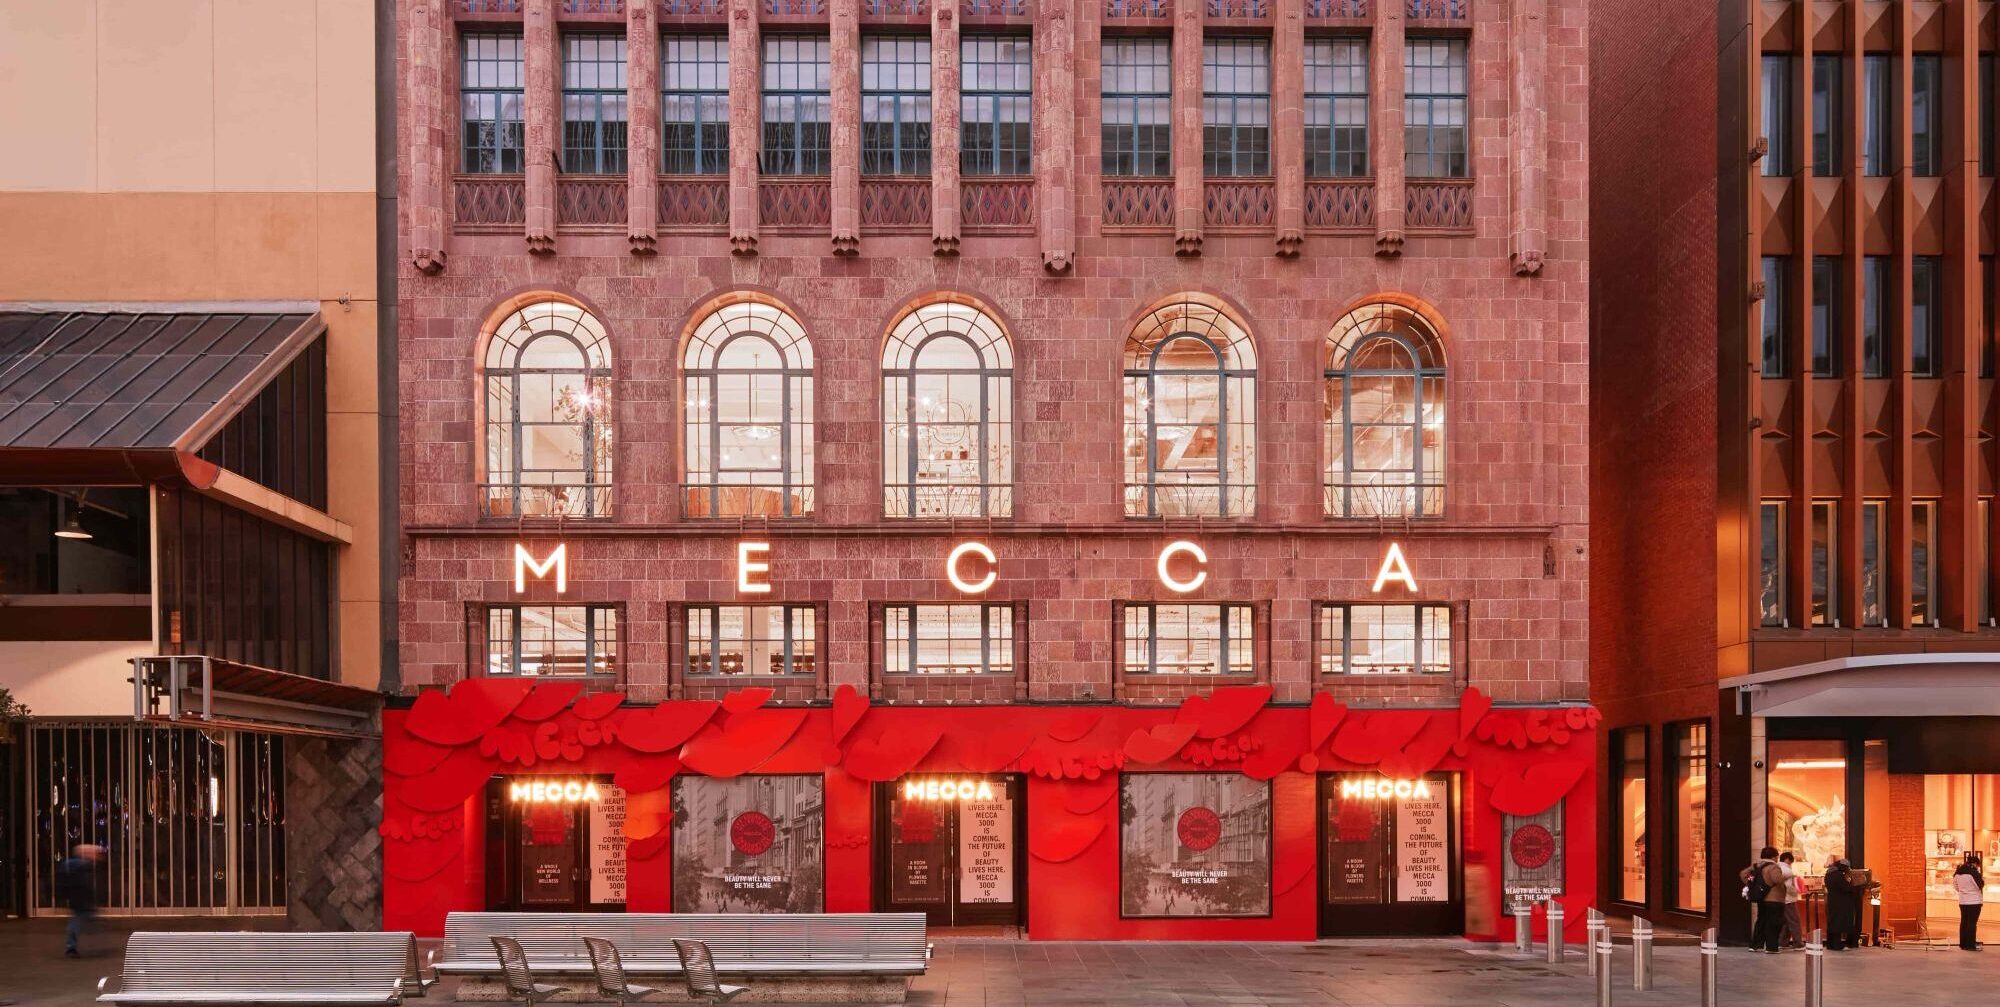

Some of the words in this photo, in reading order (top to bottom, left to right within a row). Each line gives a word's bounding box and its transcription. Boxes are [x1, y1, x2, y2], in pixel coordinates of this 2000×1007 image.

[515, 541, 1418, 594] MECCA
[511, 782, 600, 801] MECCA
[905, 781, 993, 800] MECCA
[1342, 780, 1430, 800] MECCA
